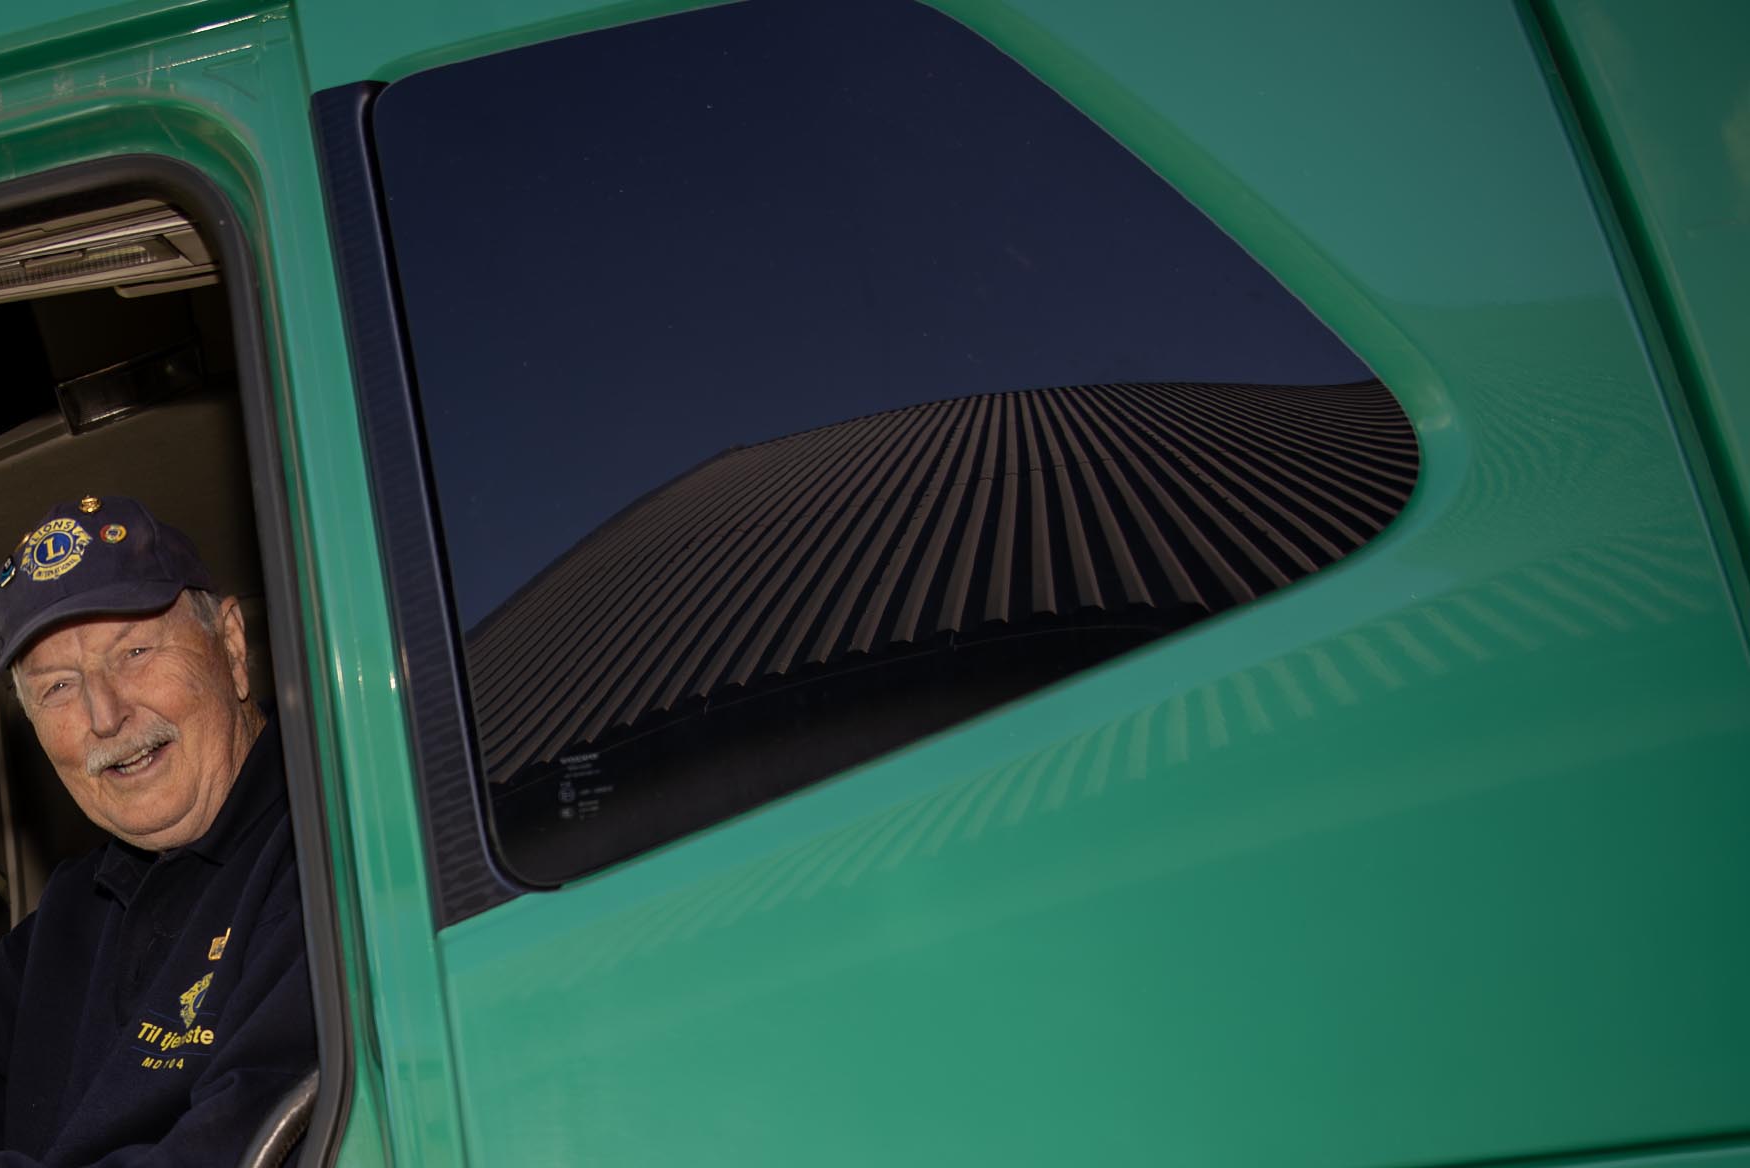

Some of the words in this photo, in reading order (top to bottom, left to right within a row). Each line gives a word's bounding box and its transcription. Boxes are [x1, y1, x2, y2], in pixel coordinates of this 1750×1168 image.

[31, 520, 73, 543] LIONS
[43, 537, 65, 561] L
[138, 1022, 163, 1043] Til
